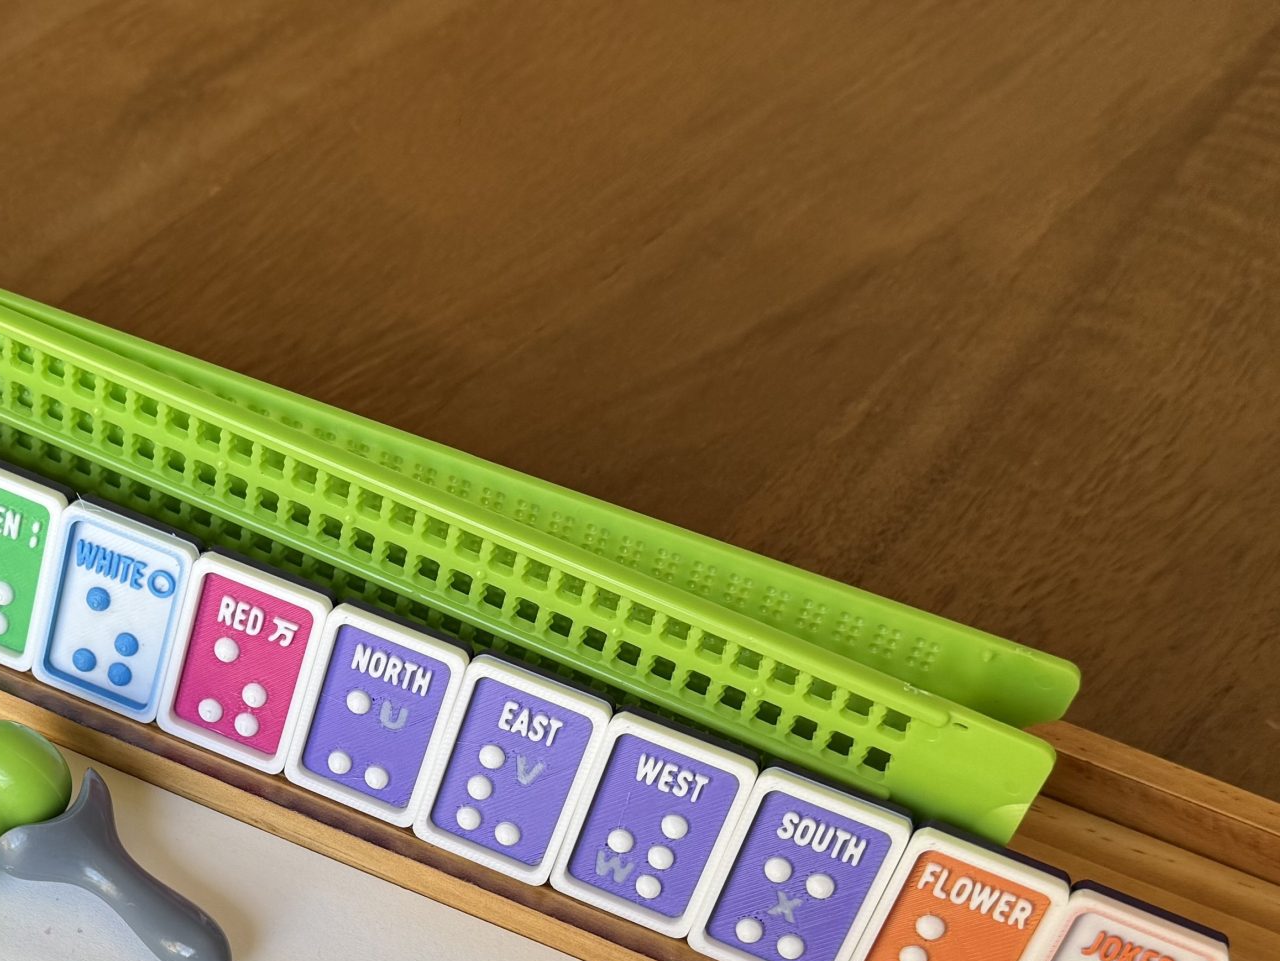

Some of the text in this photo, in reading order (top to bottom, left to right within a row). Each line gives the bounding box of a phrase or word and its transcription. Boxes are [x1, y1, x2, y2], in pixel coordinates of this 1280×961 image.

[75, 538, 148, 591] WHITE
[216, 594, 265, 637] RED
[350, 642, 433, 698] NORTH
[378, 699, 409, 731] U
[497, 700, 564, 747] EAST
[514, 754, 544, 786] V
[635, 752, 710, 803] WEST
[776, 811, 868, 868] SOUTH
[595, 849, 635, 884] W
[766, 890, 803, 924] X
[916, 862, 1034, 931] FLOWER
